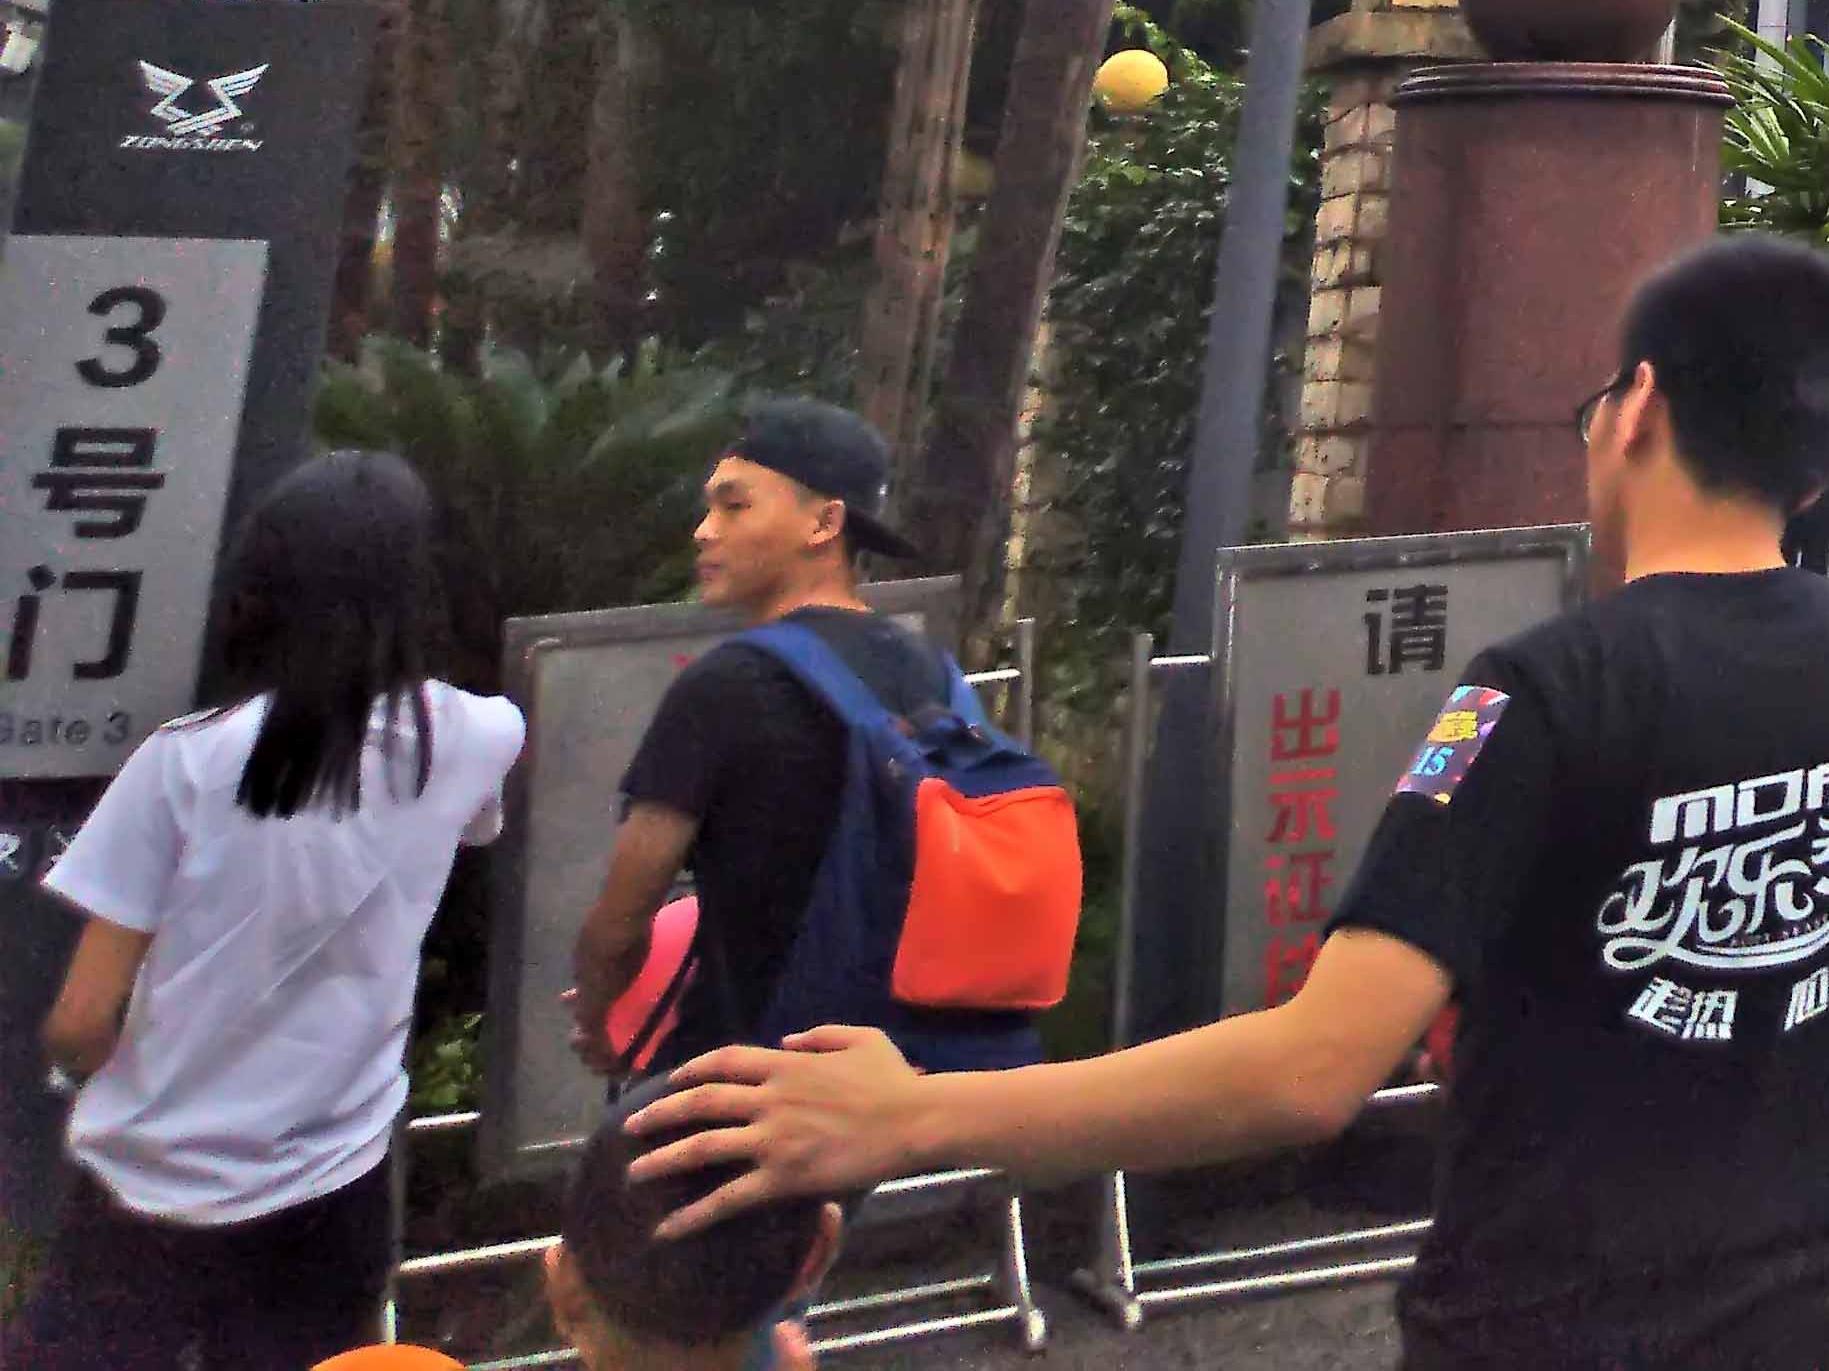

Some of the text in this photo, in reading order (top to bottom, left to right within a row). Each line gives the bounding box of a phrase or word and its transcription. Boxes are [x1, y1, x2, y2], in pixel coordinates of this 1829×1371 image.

[9, 284, 168, 681] 3号门
[1363, 584, 1449, 676] 请
[103, 711, 130, 746] 3
